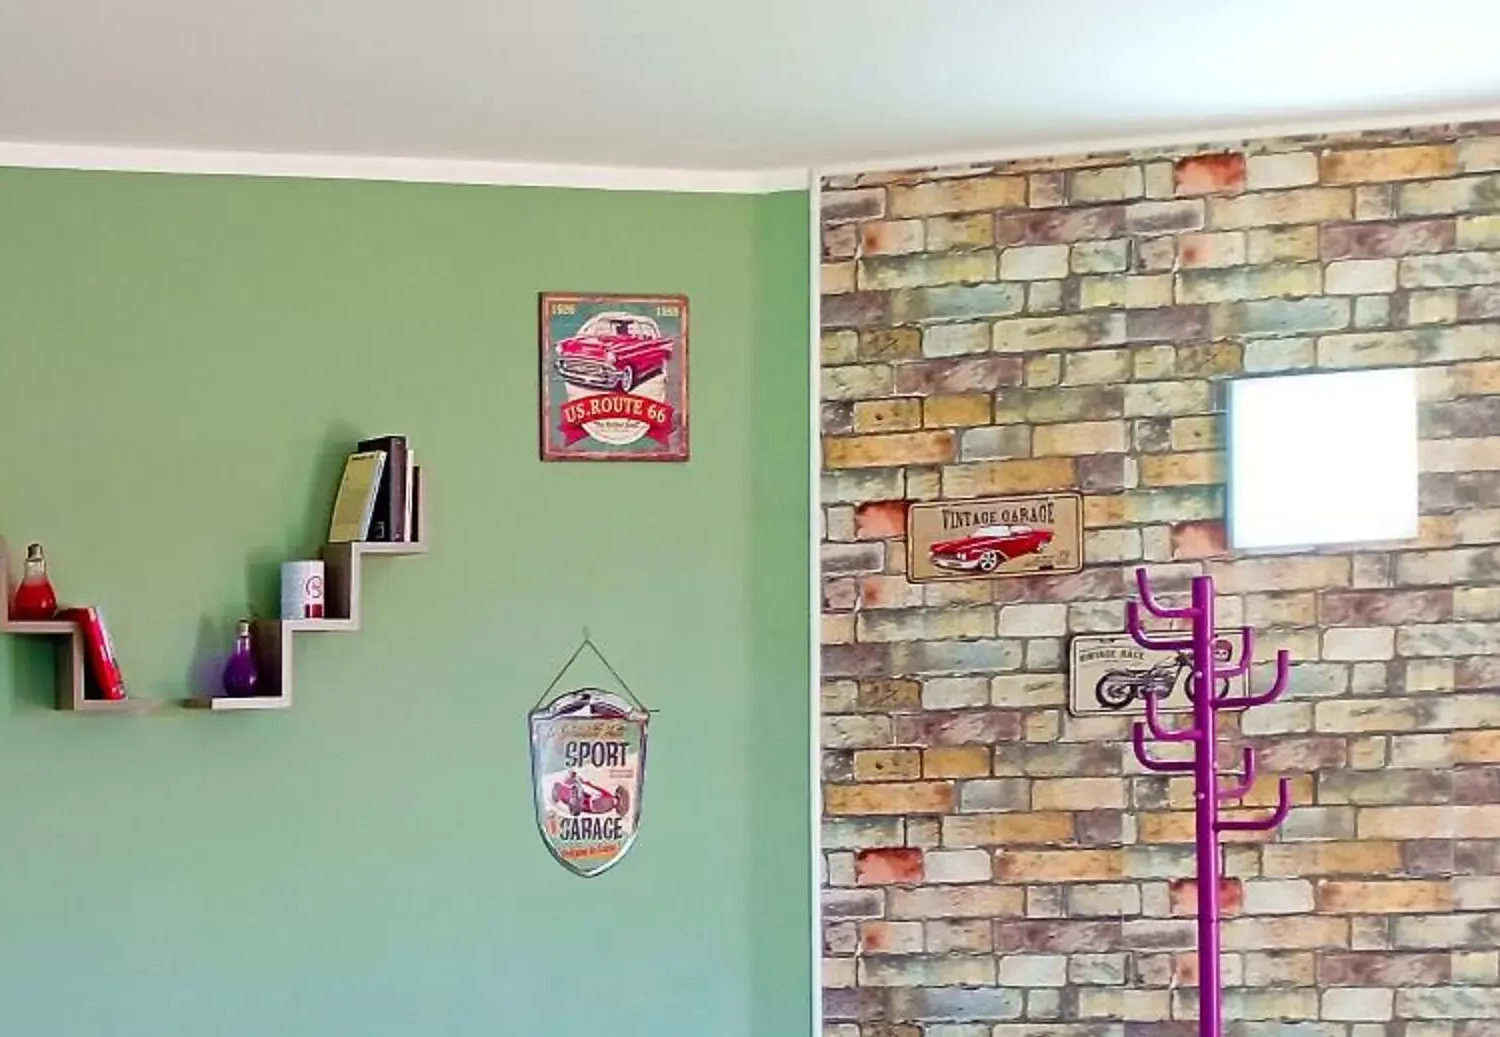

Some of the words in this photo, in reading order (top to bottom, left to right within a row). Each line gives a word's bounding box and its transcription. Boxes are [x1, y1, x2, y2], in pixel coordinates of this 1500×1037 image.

[647, 404, 667, 423] 66
[941, 509, 997, 530] VINTAGE
[1001, 501, 1055, 524] GARAGE
[565, 741, 630, 768] SPORT
[560, 817, 623, 841] GARAGE
